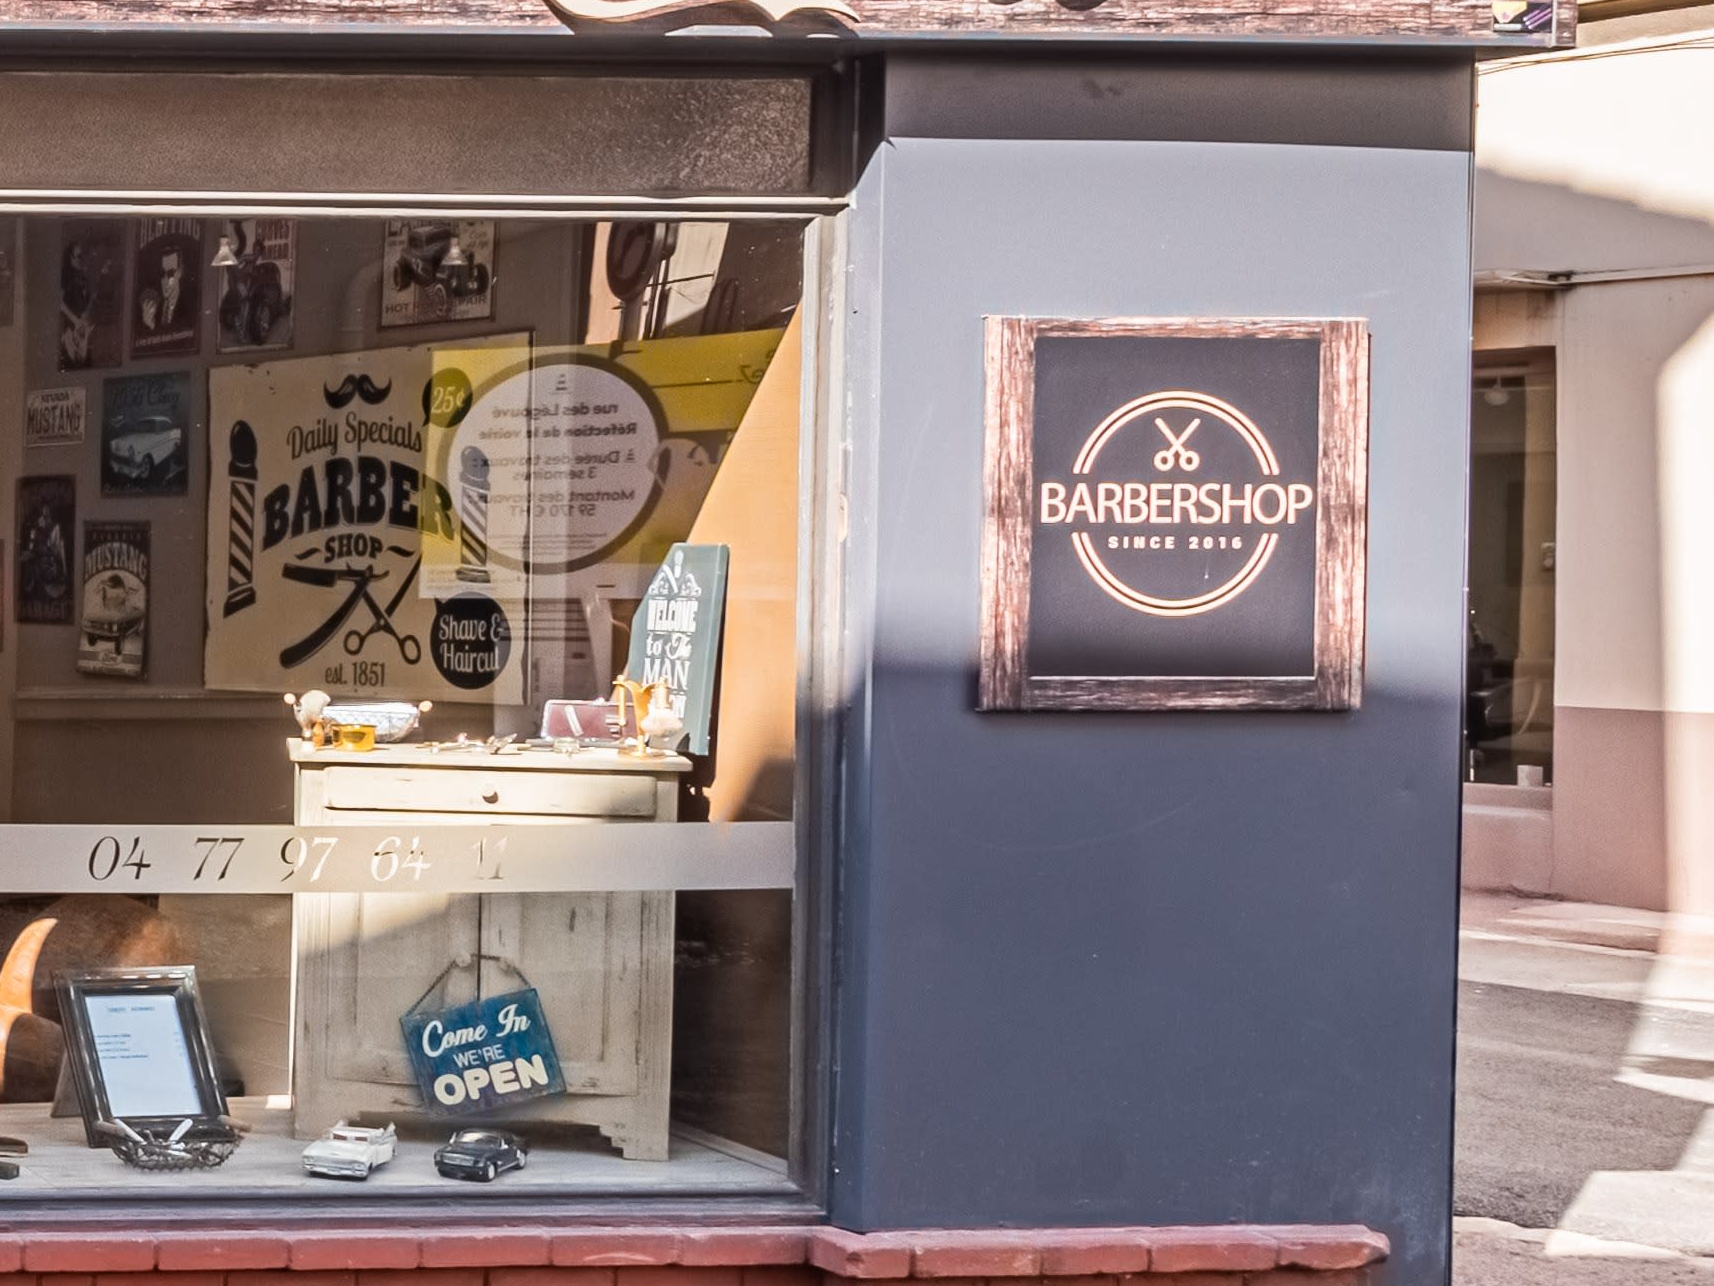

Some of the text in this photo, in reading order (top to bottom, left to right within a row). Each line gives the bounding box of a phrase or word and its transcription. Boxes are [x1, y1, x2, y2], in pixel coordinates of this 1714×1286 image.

[432, 385, 464, 414] 25¢
[286, 412, 423, 460] Daily Specials
[261, 455, 457, 551] BARBER
[1039, 481, 1314, 525] BARBERSHOP
[323, 532, 384, 564] SHOP
[1107, 535, 1243, 550] SINCE 2016
[439, 613, 487, 642] Shave
[645, 632, 663, 656] to
[324, 661, 386, 687] est. 1851
[641, 657, 691, 691] MAN
[88, 835, 152, 881] 04
[192, 836, 246, 882] 77
[280, 836, 340, 883] 97
[370, 835, 432, 883] 64
[421, 1003, 532, 1058] Come In
[452, 1043, 507, 1068] WE'RE
[433, 1053, 550, 1106] OPEN
